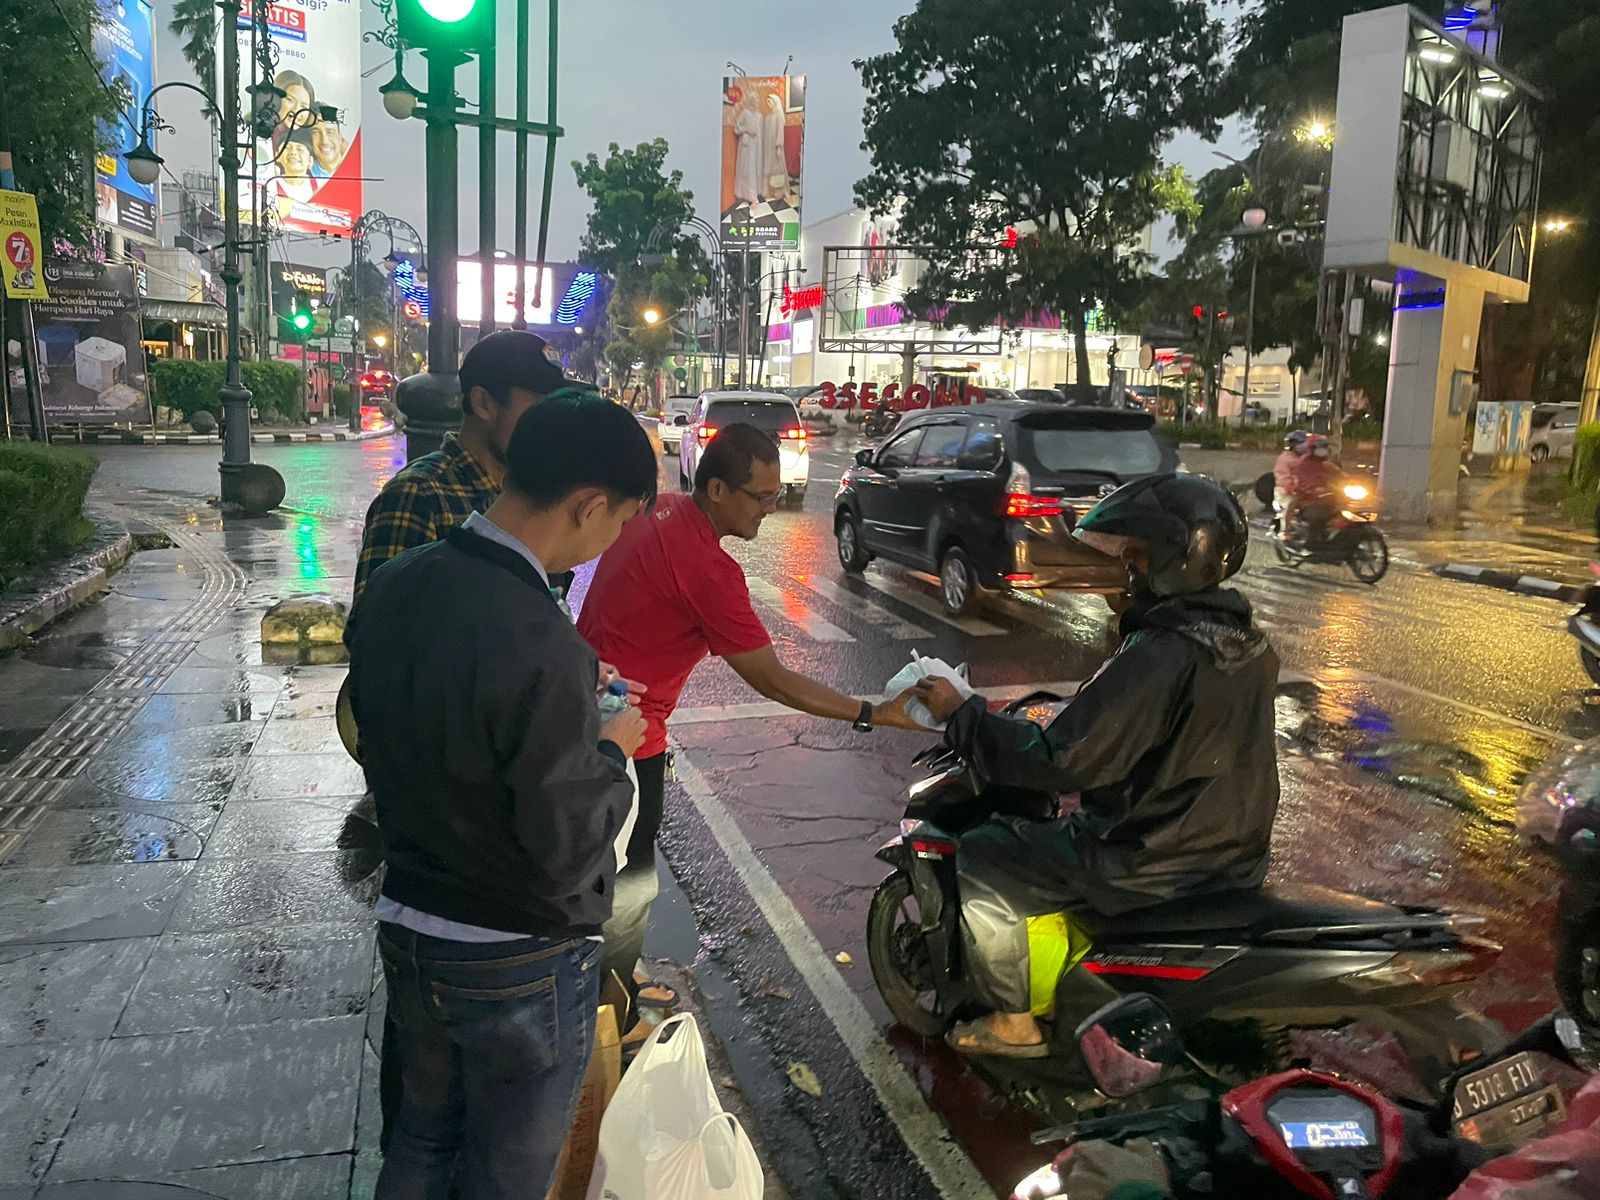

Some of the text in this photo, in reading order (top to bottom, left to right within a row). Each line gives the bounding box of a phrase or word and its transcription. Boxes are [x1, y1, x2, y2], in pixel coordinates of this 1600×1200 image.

[5, 207, 27, 218] Pesan
[60, 296, 97, 306] Cookies
[99, 300, 125, 308] untuk
[34, 304, 115, 317] Hampers Hari Raya
